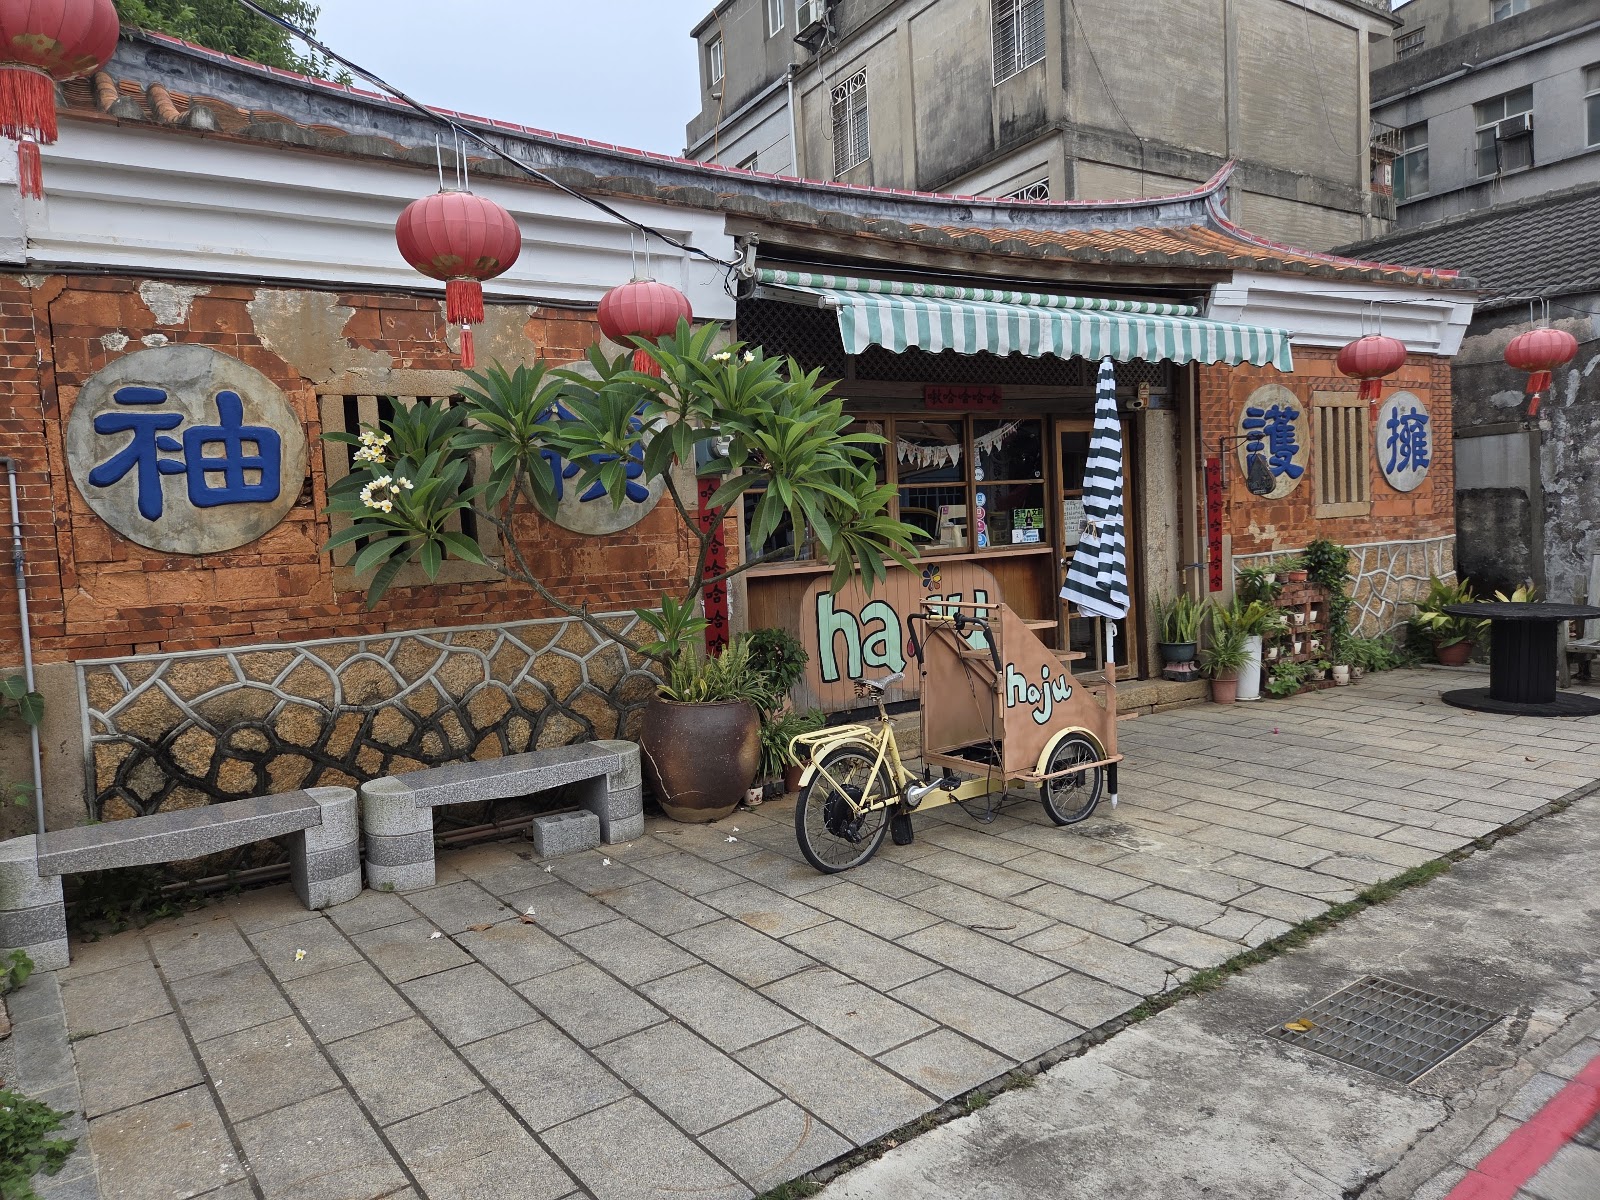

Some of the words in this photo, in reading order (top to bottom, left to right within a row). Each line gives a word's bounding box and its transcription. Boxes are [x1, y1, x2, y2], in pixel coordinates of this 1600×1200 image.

[88, 386, 281, 522] 袖
[1242, 404, 1305, 479] 護
[1386, 406, 1430, 475] 擁
[1208, 463, 1222, 588] 哈哈哈哈哈哈哈
[1006, 663, 1072, 725] haju
